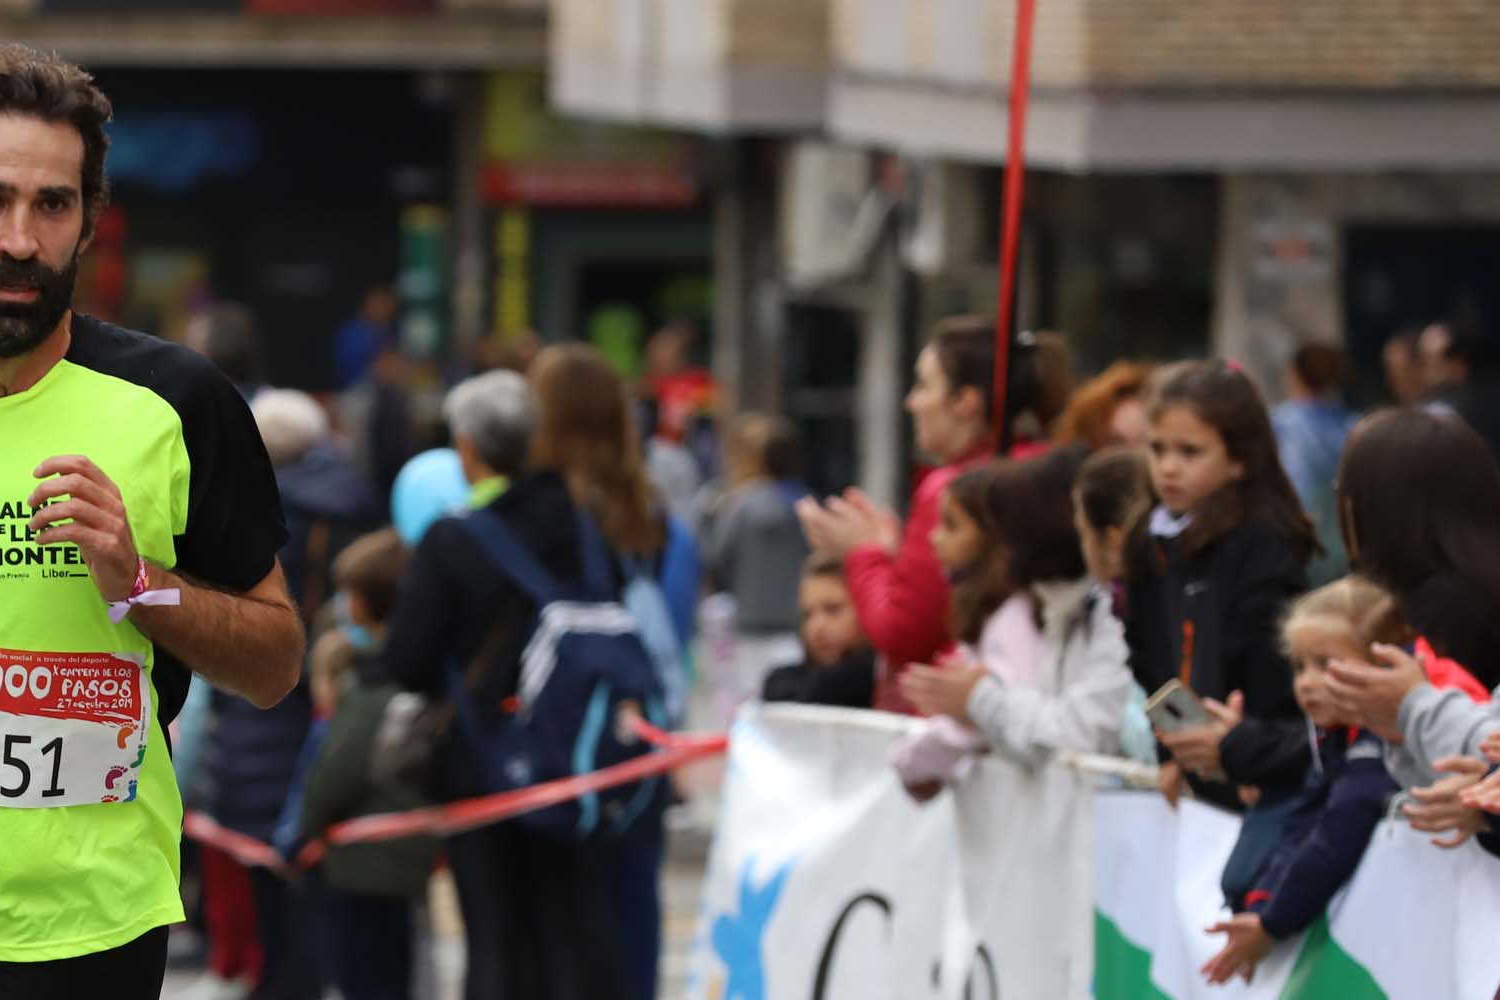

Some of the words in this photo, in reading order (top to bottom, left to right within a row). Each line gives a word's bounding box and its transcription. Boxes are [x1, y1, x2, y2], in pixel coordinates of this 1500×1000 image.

[10, 524, 53, 542] LE
[9, 654, 33, 662] social
[81, 656, 109, 664] deporte
[102, 668, 112, 677] DE
[114, 667, 132, 678] LOS
[61, 678, 132, 699] PASOS
[57, 698, 72, 709] 27
[73, 698, 110, 709] octubre
[111, 698, 133, 708] 2019
[0, 734, 65, 798] 51
